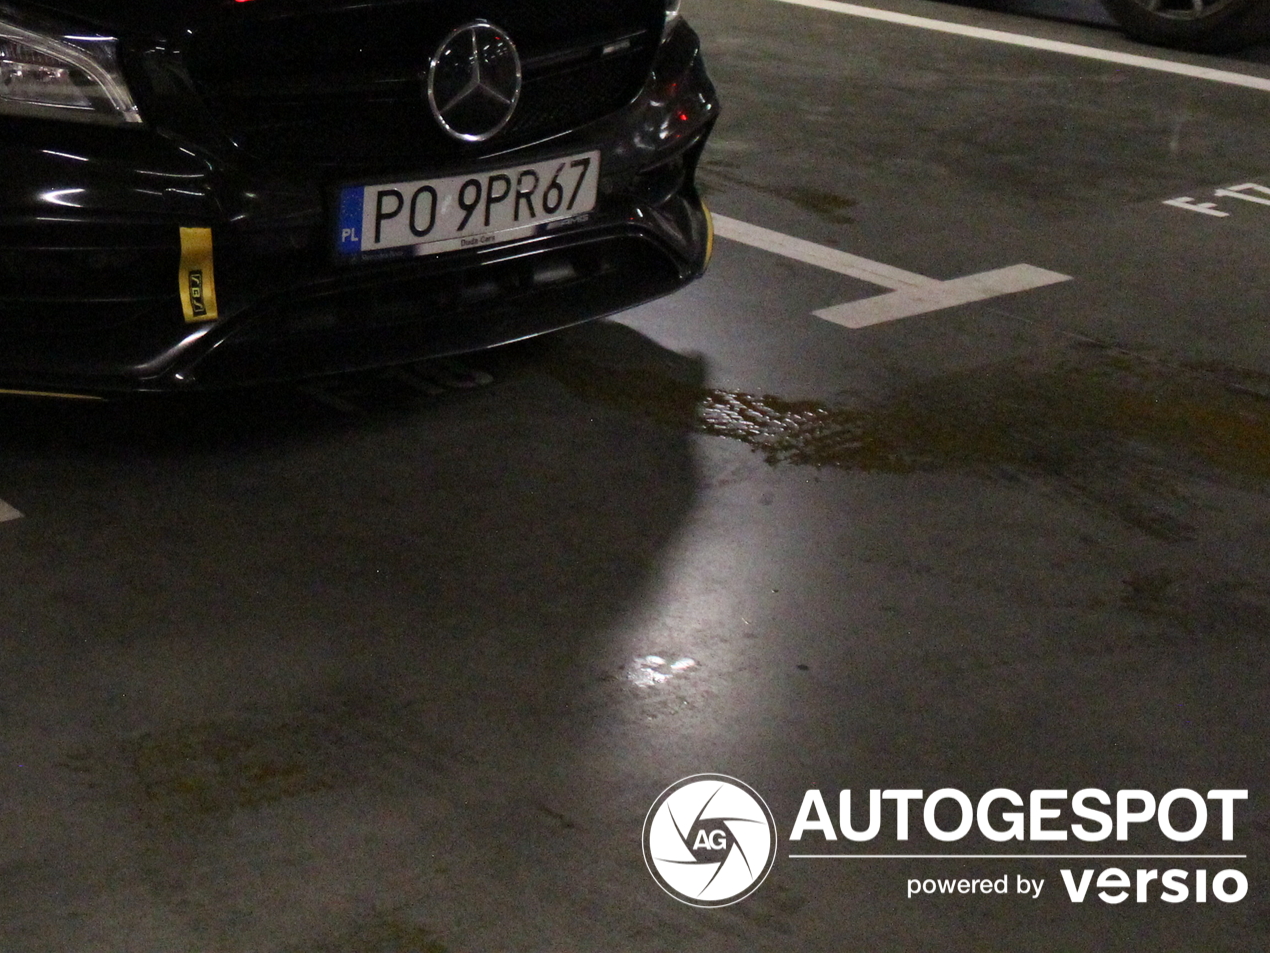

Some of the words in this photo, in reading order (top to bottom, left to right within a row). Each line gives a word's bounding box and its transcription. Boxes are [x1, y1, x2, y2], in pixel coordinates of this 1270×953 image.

[374, 185, 438, 244] PO
[456, 157, 591, 232] 9PR67
[342, 228, 359, 243] PL
